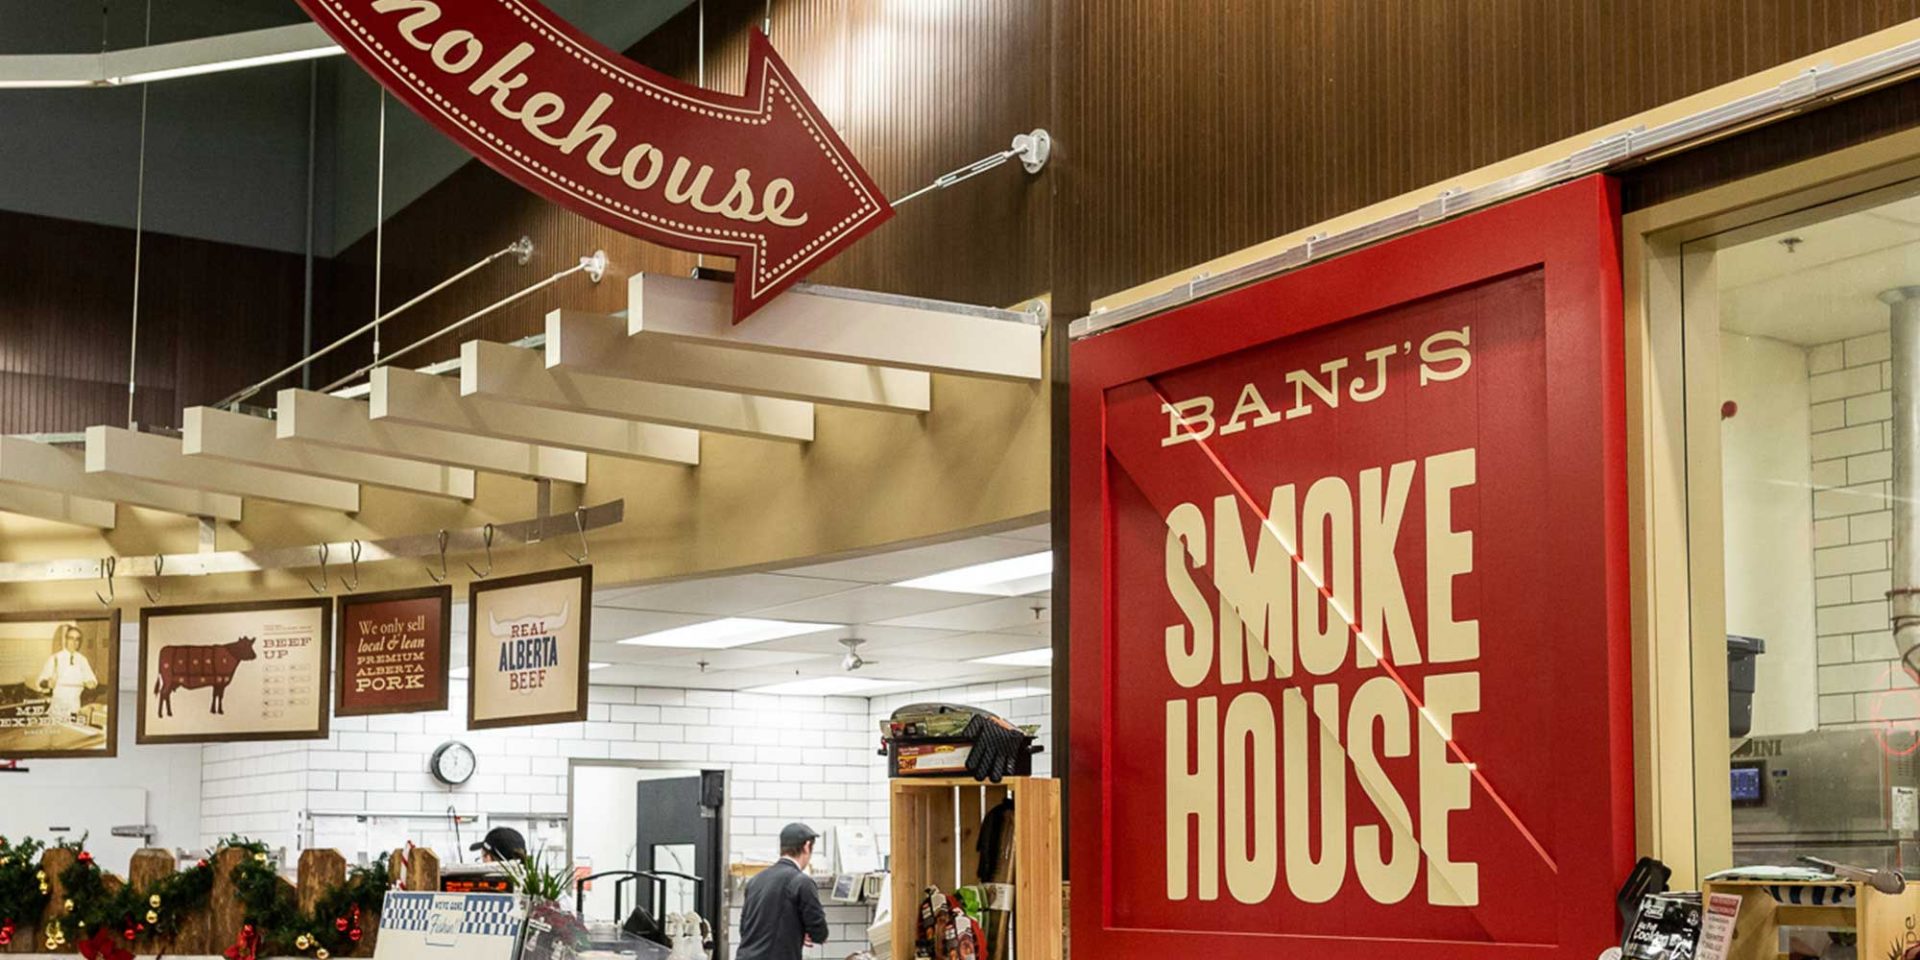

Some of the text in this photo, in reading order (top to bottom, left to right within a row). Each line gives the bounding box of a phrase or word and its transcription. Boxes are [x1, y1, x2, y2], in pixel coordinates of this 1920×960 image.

[1161, 326, 1473, 447] BANJ'S
[1165, 448, 1480, 688] SMOKE
[359, 615, 425, 636] We only sell
[511, 621, 548, 638] REAL
[263, 637, 312, 648] BEEF
[358, 634, 425, 653] local & lean
[263, 650, 289, 659] UP
[357, 652, 424, 665] PREMIUM
[499, 636, 558, 672] ALBERTA
[356, 664, 424, 677] ALBERTA
[509, 669, 547, 691] BEEF
[355, 675, 424, 692] PORK
[1166, 671, 1480, 906] HOUSE
